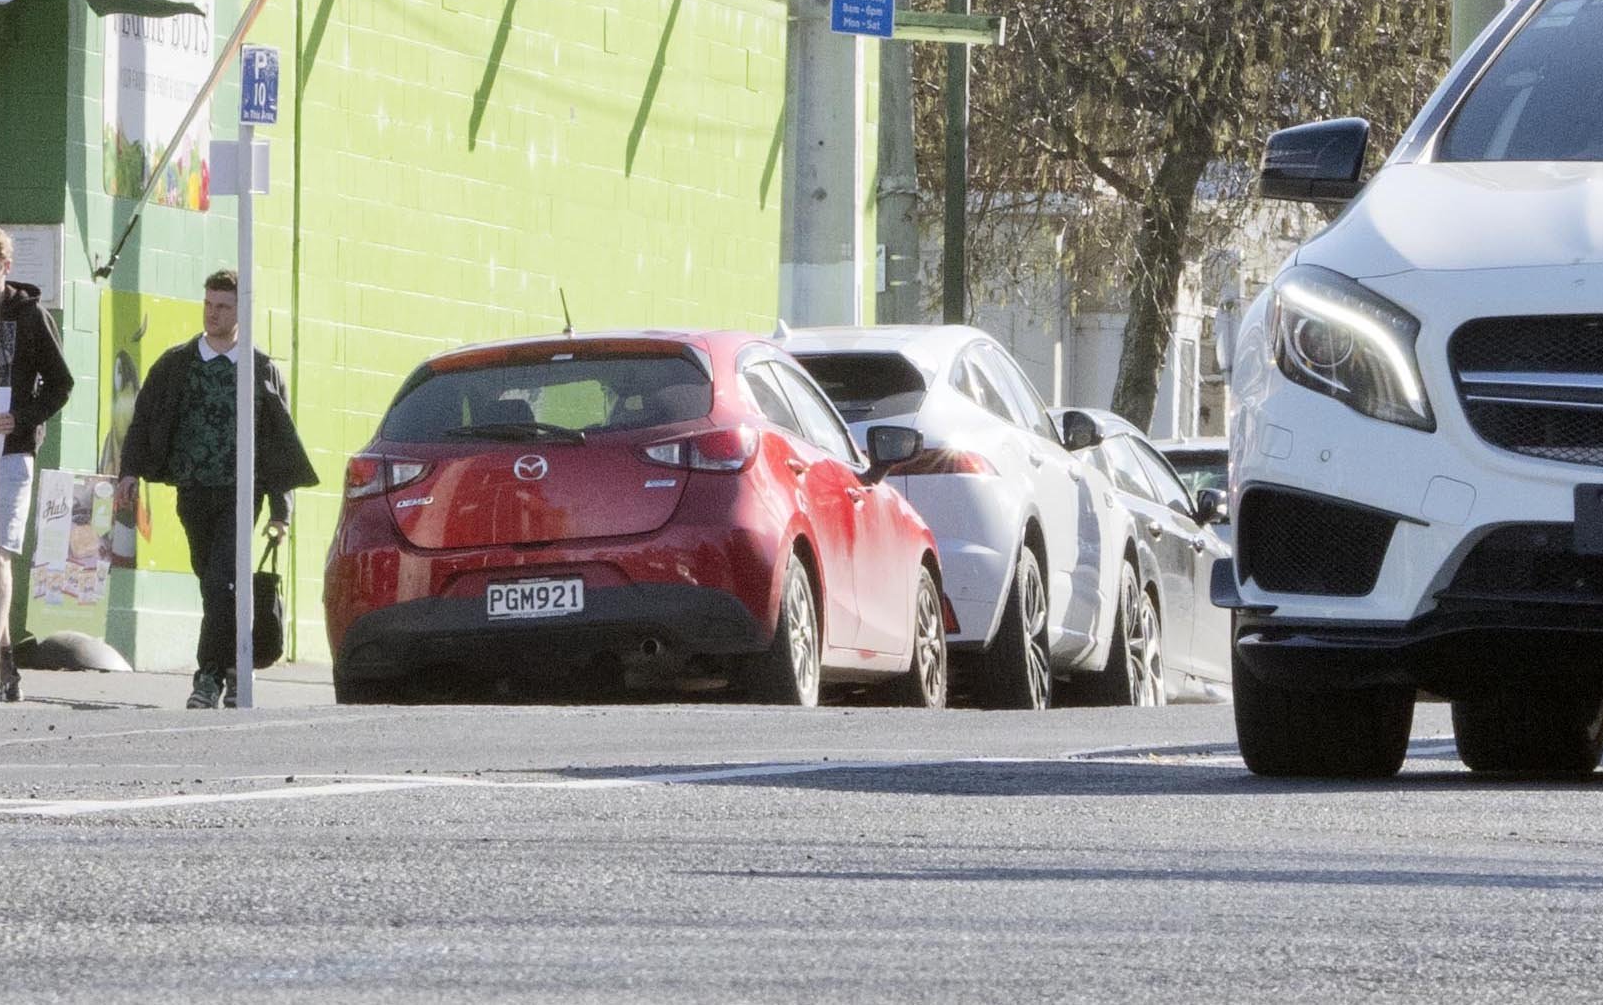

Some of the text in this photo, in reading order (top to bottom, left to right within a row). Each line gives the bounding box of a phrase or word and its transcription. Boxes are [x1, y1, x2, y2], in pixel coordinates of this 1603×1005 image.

[254, 50, 268, 81] P
[254, 81, 267, 107] 10
[489, 584, 579, 612] PGM921
